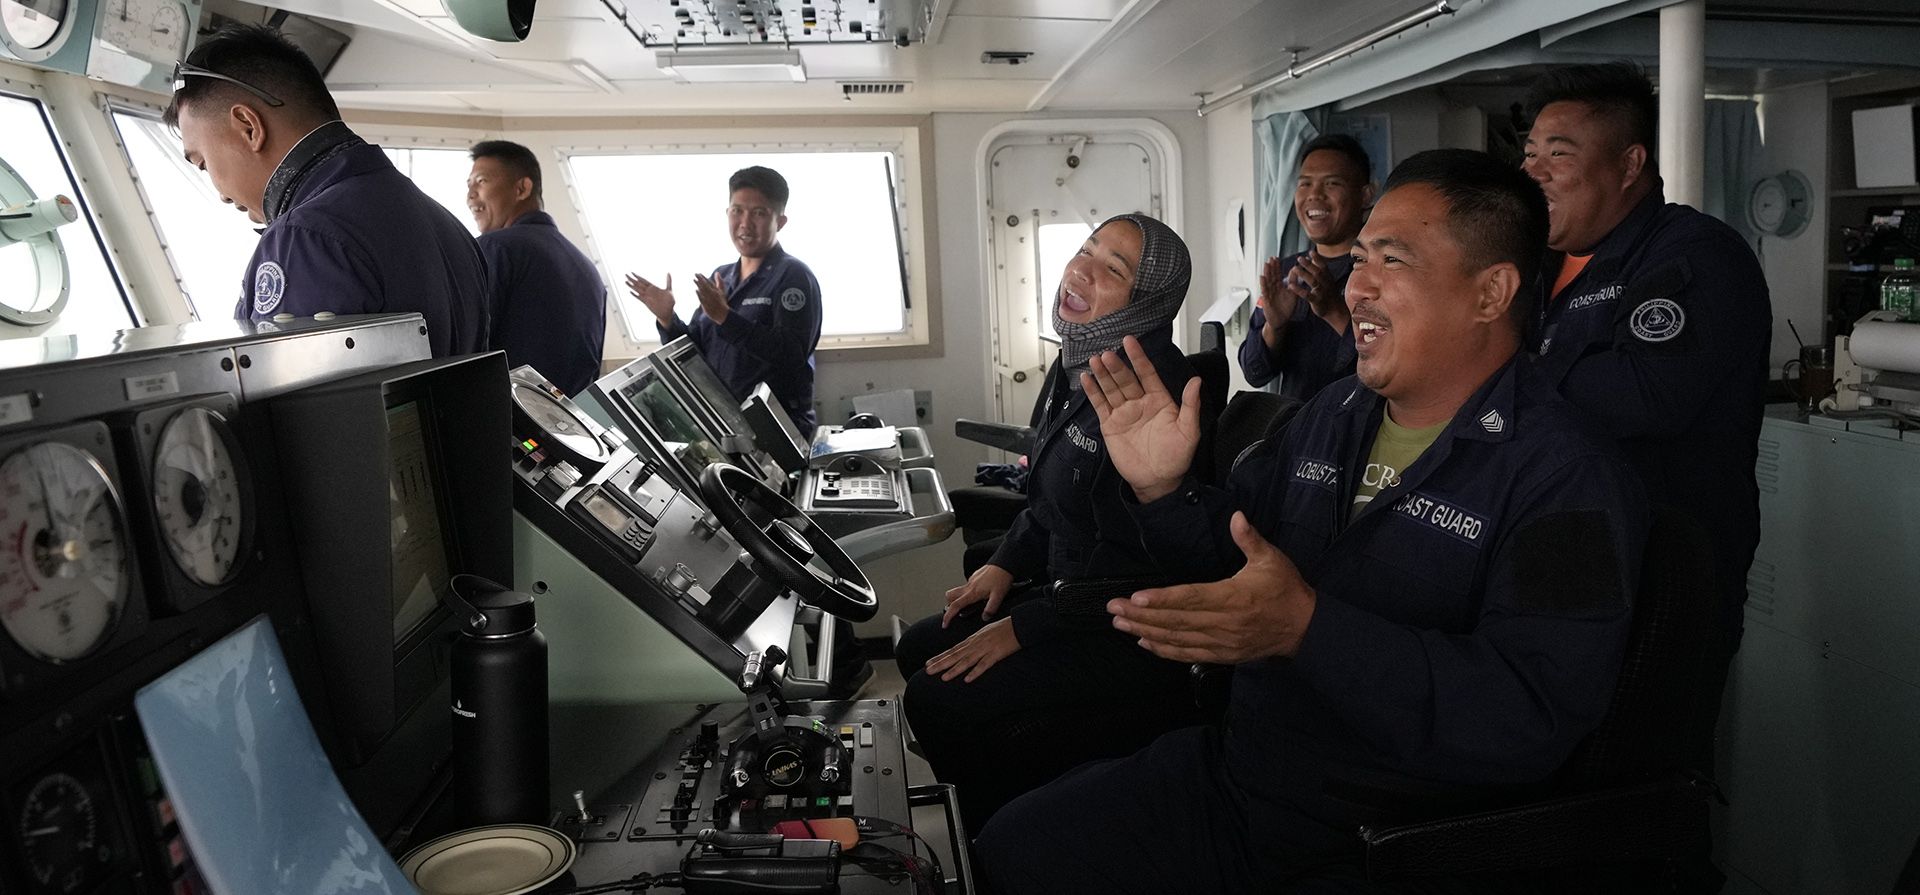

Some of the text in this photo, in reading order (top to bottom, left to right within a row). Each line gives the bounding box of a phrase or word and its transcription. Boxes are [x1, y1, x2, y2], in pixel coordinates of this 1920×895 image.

[1596, 285, 1626, 300] GUAR
[1393, 493, 1482, 540] OAST GUARD
